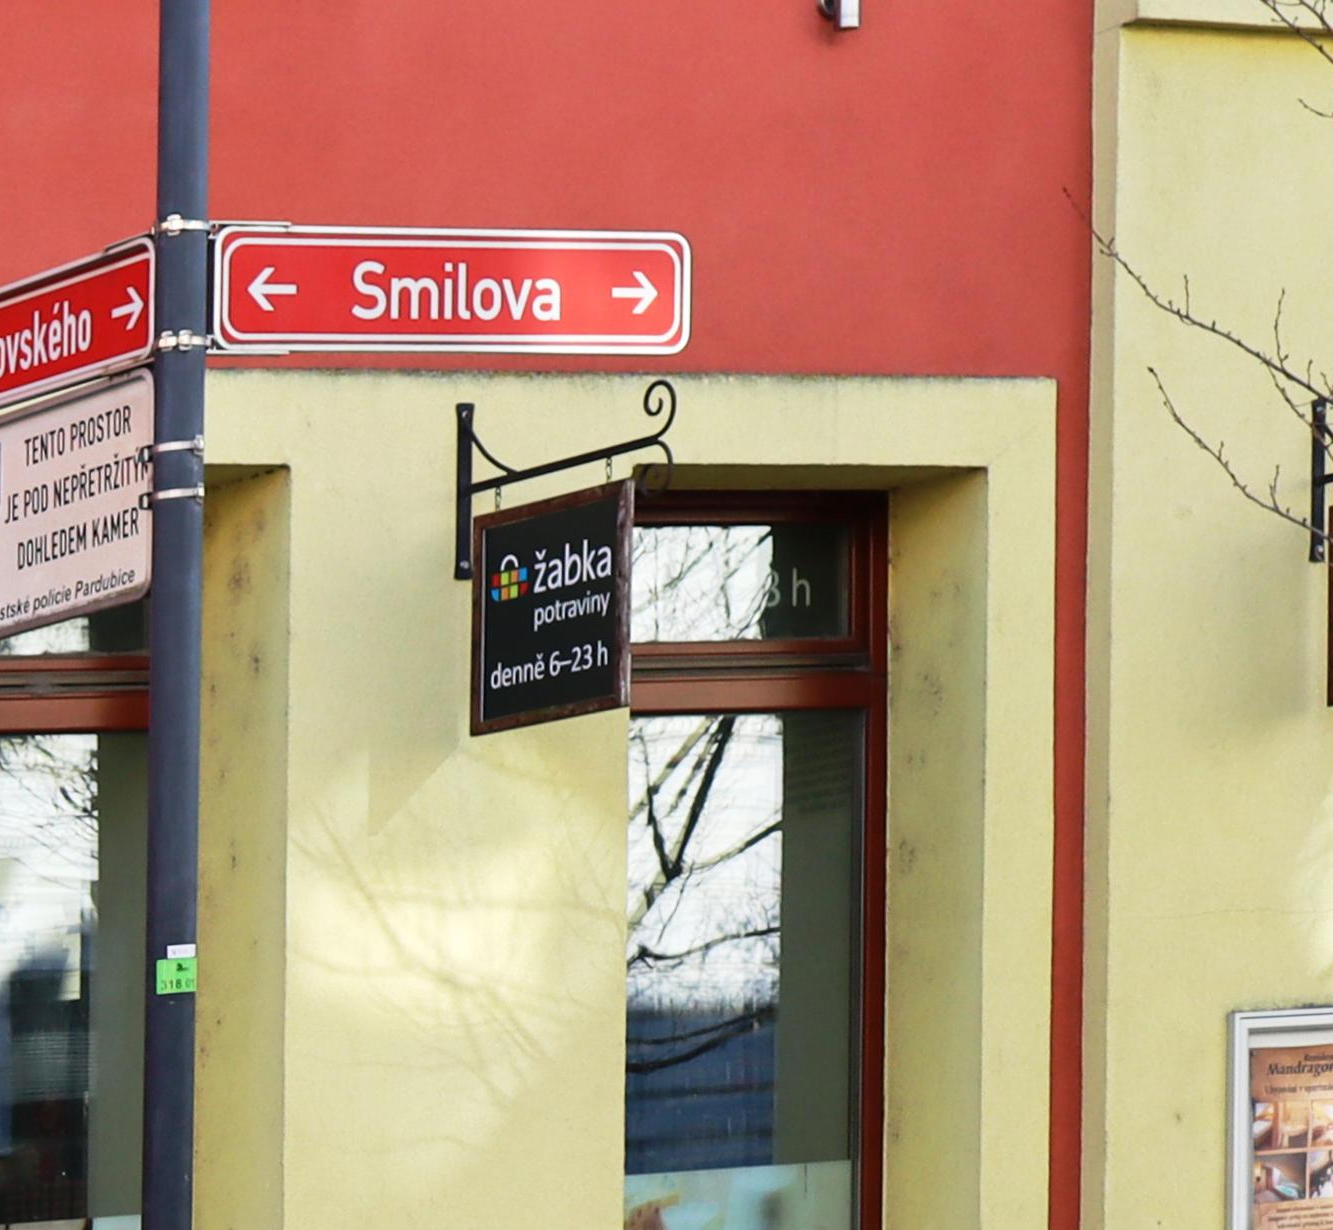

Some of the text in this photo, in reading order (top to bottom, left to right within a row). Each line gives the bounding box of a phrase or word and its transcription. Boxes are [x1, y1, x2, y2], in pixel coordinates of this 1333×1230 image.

[351, 260, 561, 321] Smilova
[24, 405, 132, 467] TENTO PROSTOR
[4, 493, 19, 524] JE
[23, 484, 49, 519] POD
[17, 506, 140, 571] DOHLEDEM KAMER
[33, 584, 72, 613] policie
[75, 568, 136, 600] Pardubice
[533, 538, 612, 594] žabka
[792, 566, 811, 607] h
[533, 590, 611, 632] potraviny
[490, 653, 545, 689] denně
[597, 639, 609, 667] h
